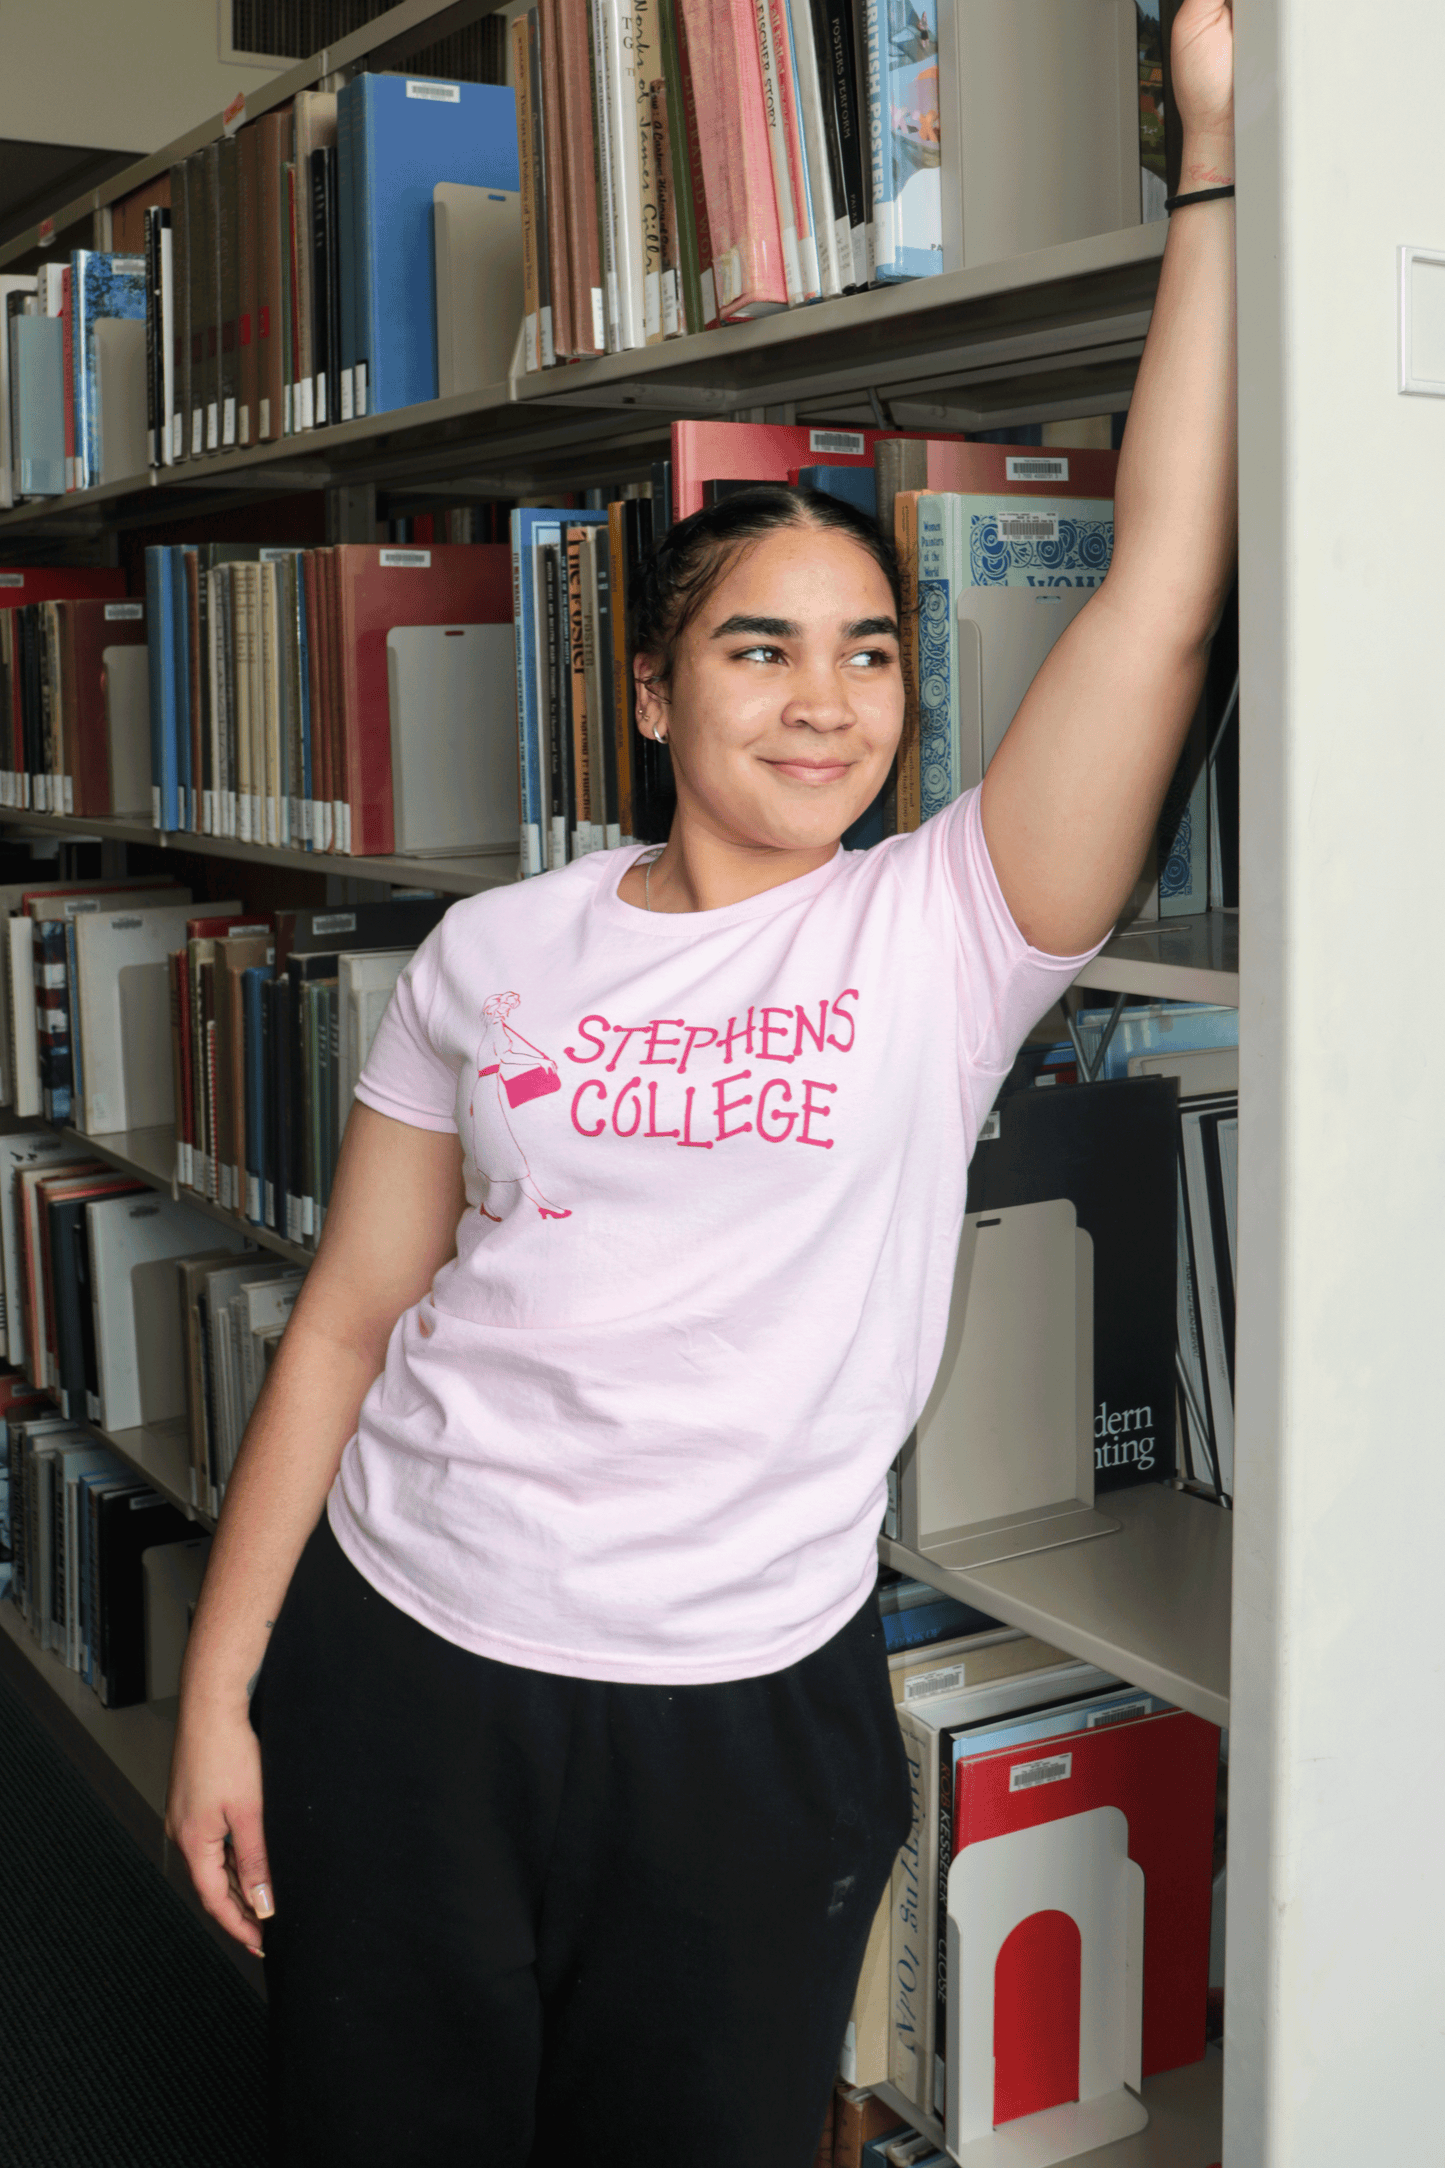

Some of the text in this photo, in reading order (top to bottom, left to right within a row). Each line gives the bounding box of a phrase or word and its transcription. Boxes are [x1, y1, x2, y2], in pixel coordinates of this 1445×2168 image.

[756, 0, 777, 128] EISCHER STORY
[832, 18, 844, 75] POSTERS
[838, 79, 851, 138] PERFORM
[867, 0, 881, 91] RITISH
[638, 78, 650, 104] of
[640, 117, 651, 192] James
[654, 131, 664, 174] Cartoon
[869, 102, 885, 204] POSTER
[658, 177, 667, 222] History
[924, 552, 940, 562] of the
[584, 614, 595, 666] POSTER
[903, 644, 912, 695] HAND
[564, 988, 859, 1074] STEPHENS
[571, 1070, 837, 1149] COLLEGE
[1094, 1402, 1153, 1438] dern
[940, 1761, 952, 1808] ROB
[939, 1808, 951, 1905] KESSELER
[937, 1938, 948, 2004] CLOSE
